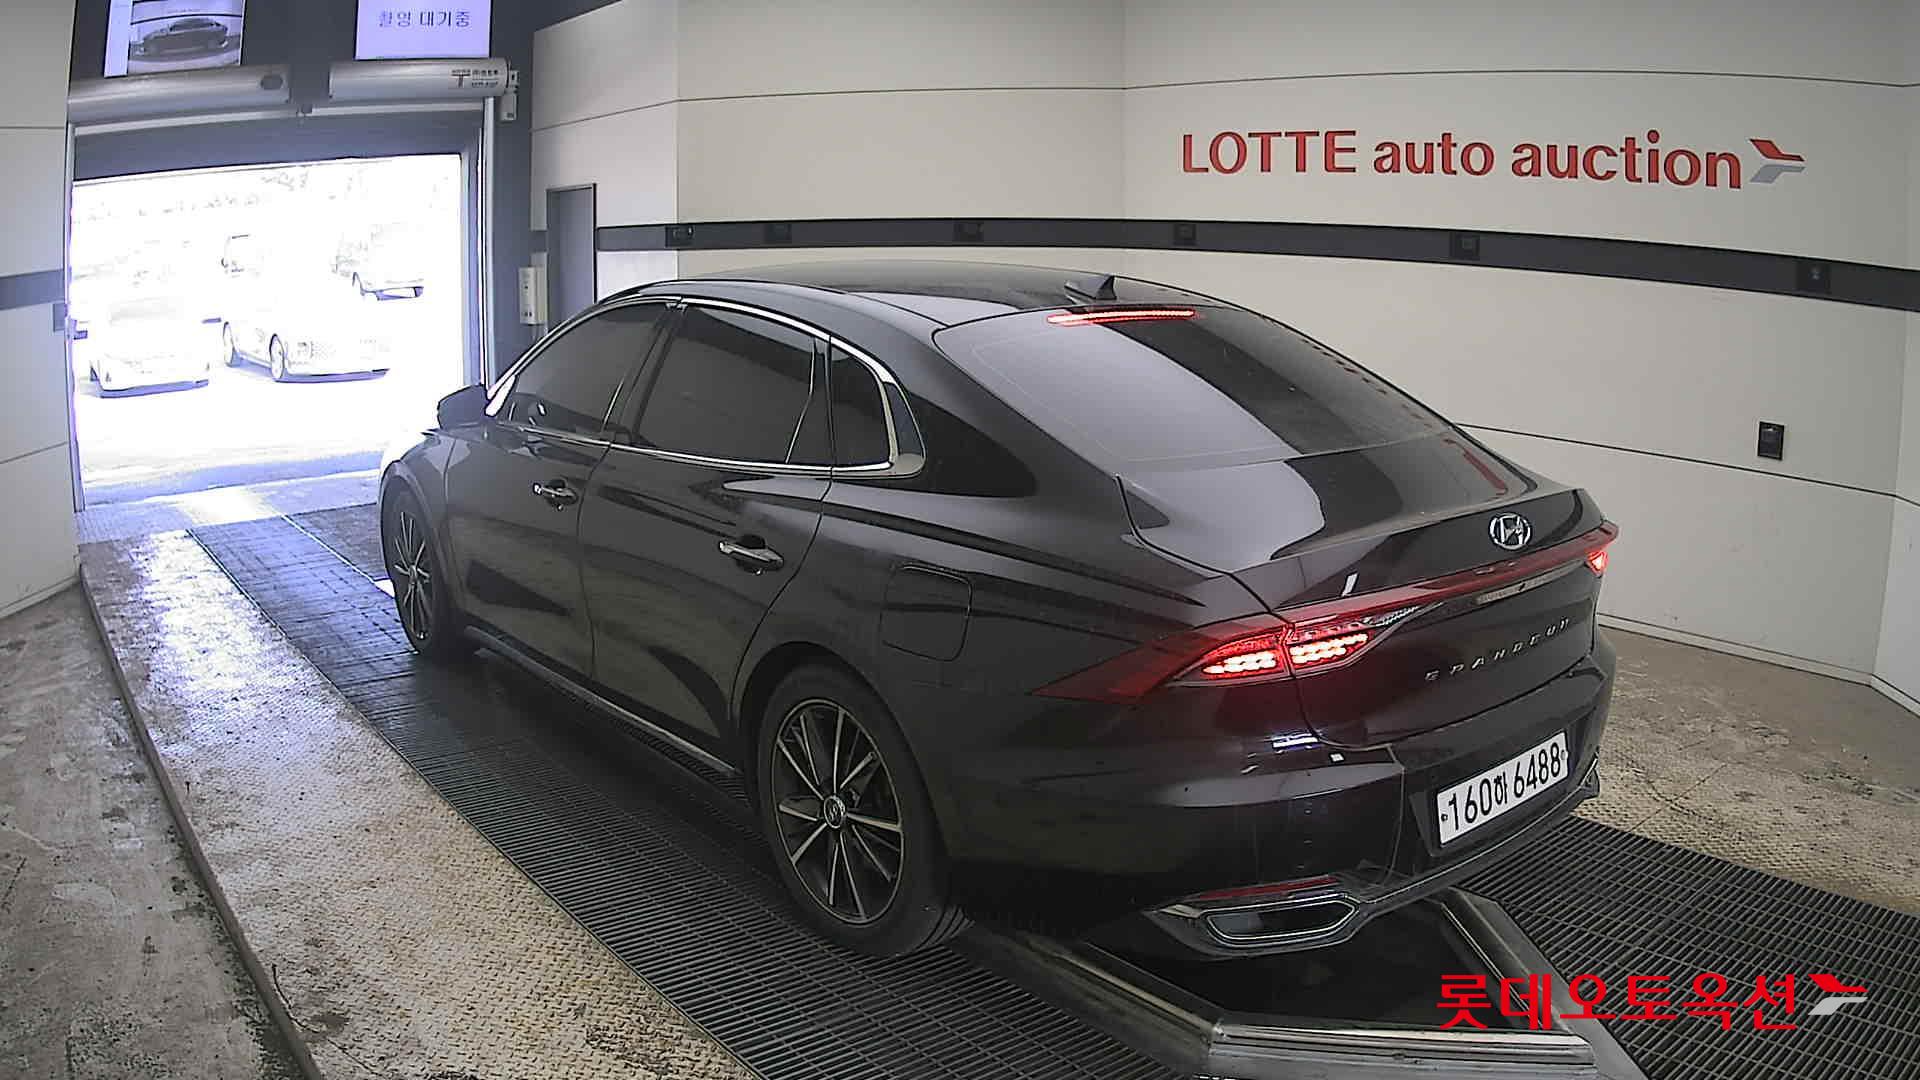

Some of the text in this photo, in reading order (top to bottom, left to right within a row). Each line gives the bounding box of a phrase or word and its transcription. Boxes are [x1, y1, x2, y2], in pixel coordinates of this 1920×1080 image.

[419, 10, 471, 28] 대기중
[1182, 130, 1742, 189] LOTTE auto auction
